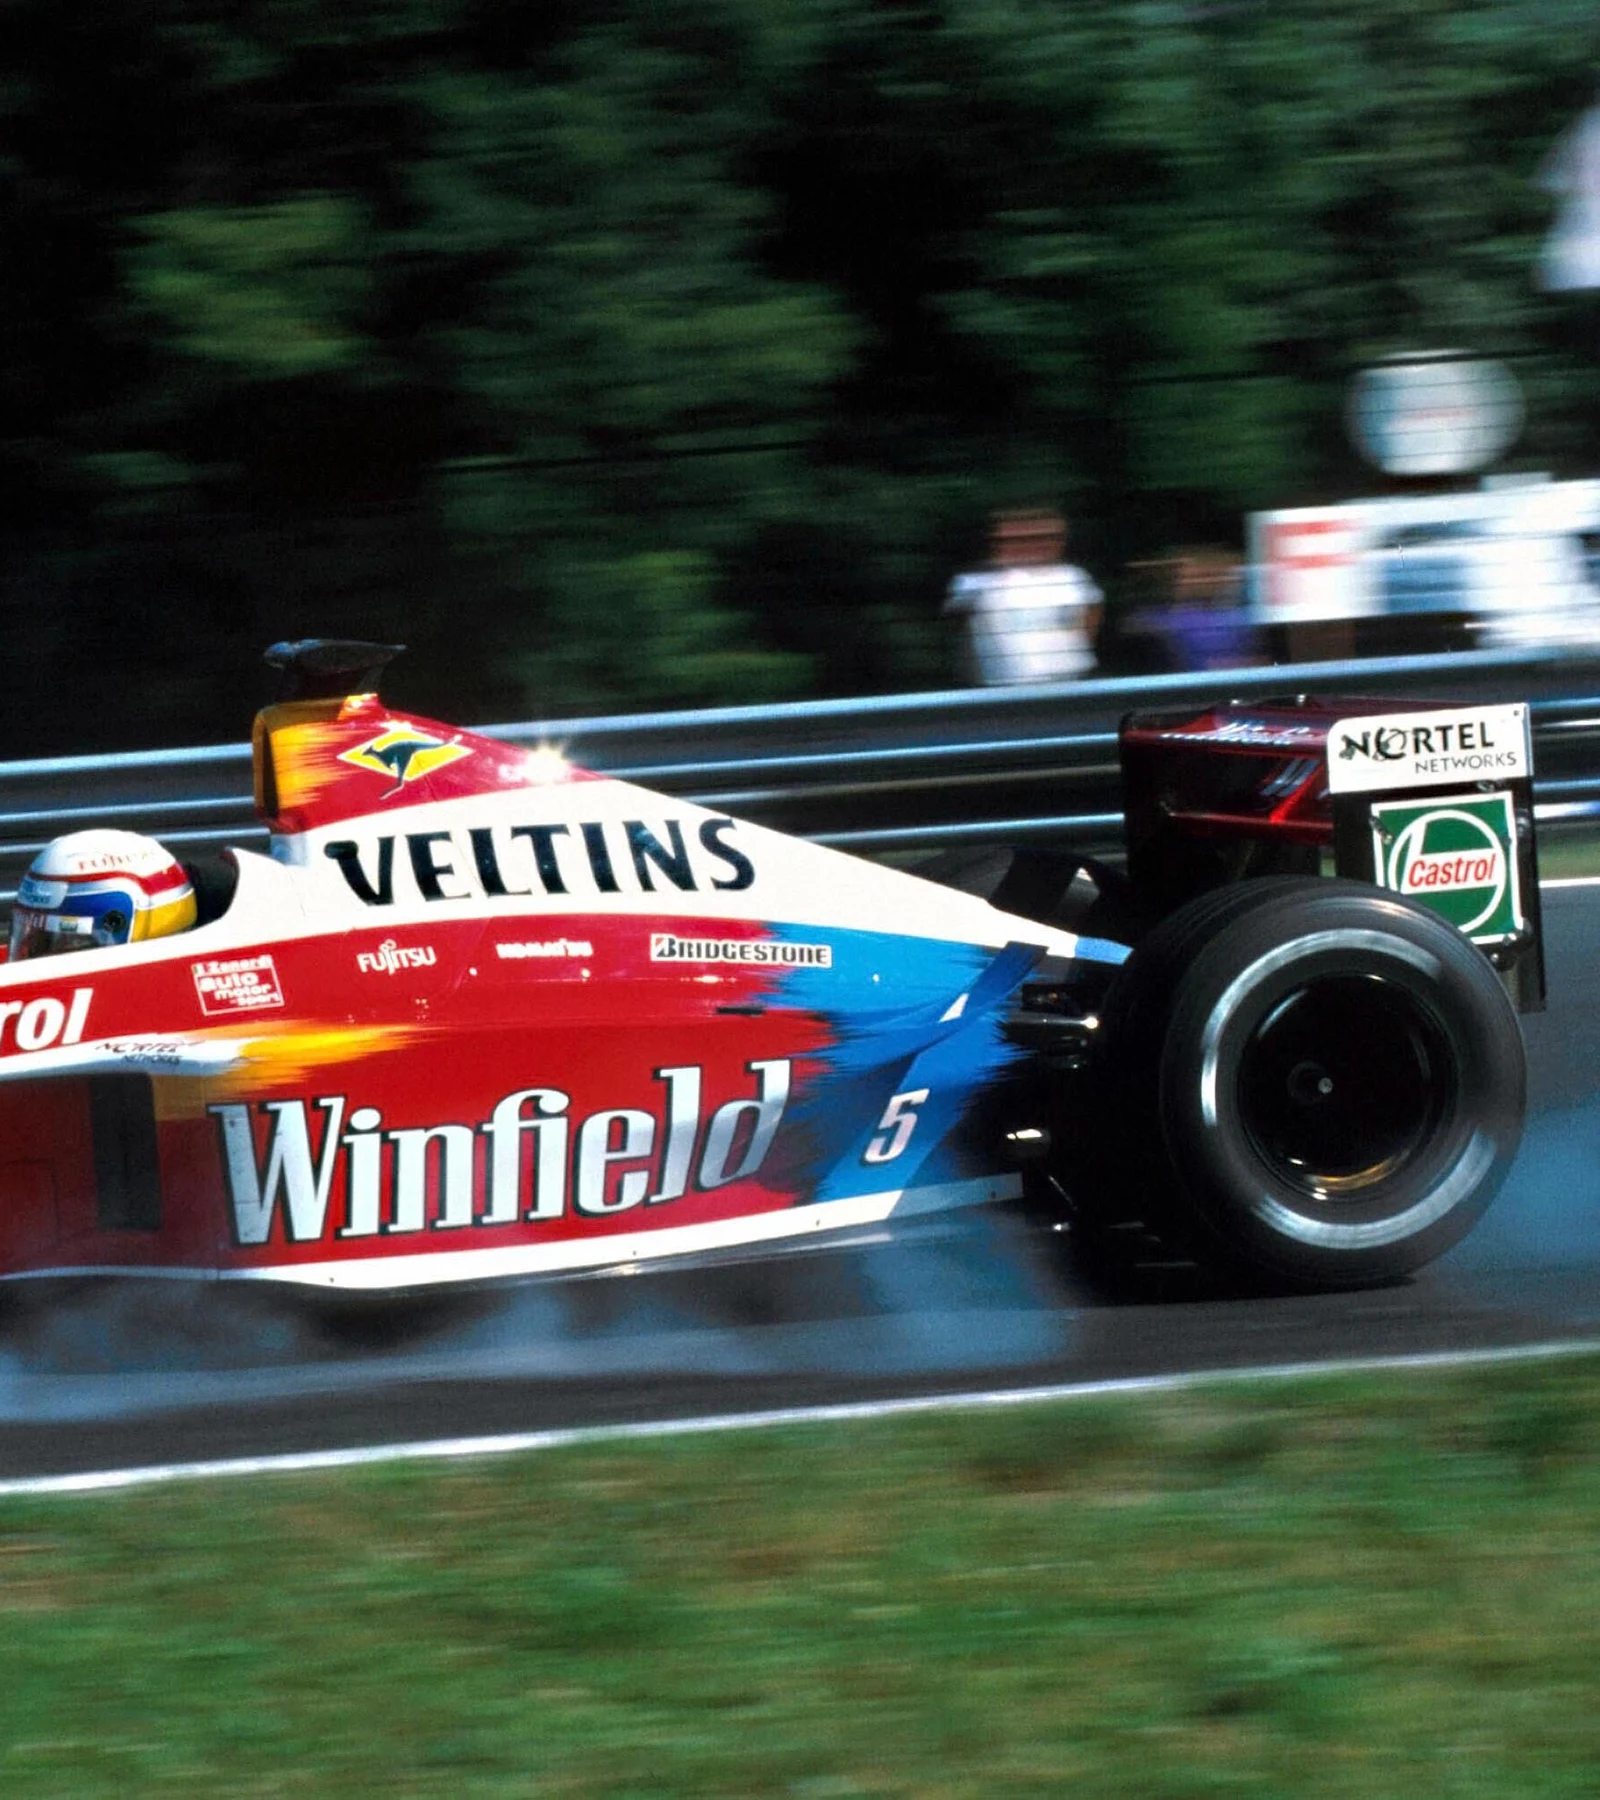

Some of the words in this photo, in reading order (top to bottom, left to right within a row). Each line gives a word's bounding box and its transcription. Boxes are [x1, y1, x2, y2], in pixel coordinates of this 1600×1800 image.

[1339, 721, 1495, 761] NORTEL
[1415, 751, 1518, 774] NETWORKS
[323, 817, 756, 907] VELTINS
[1408, 852, 1497, 888] Castrol
[356, 938, 437, 975] FUJITSU
[655, 936, 829, 965] BRIDGESTONE
[215, 983, 272, 1000] motor
[863, 1086, 931, 1164] 5
[208, 1057, 792, 1246] Winfield
